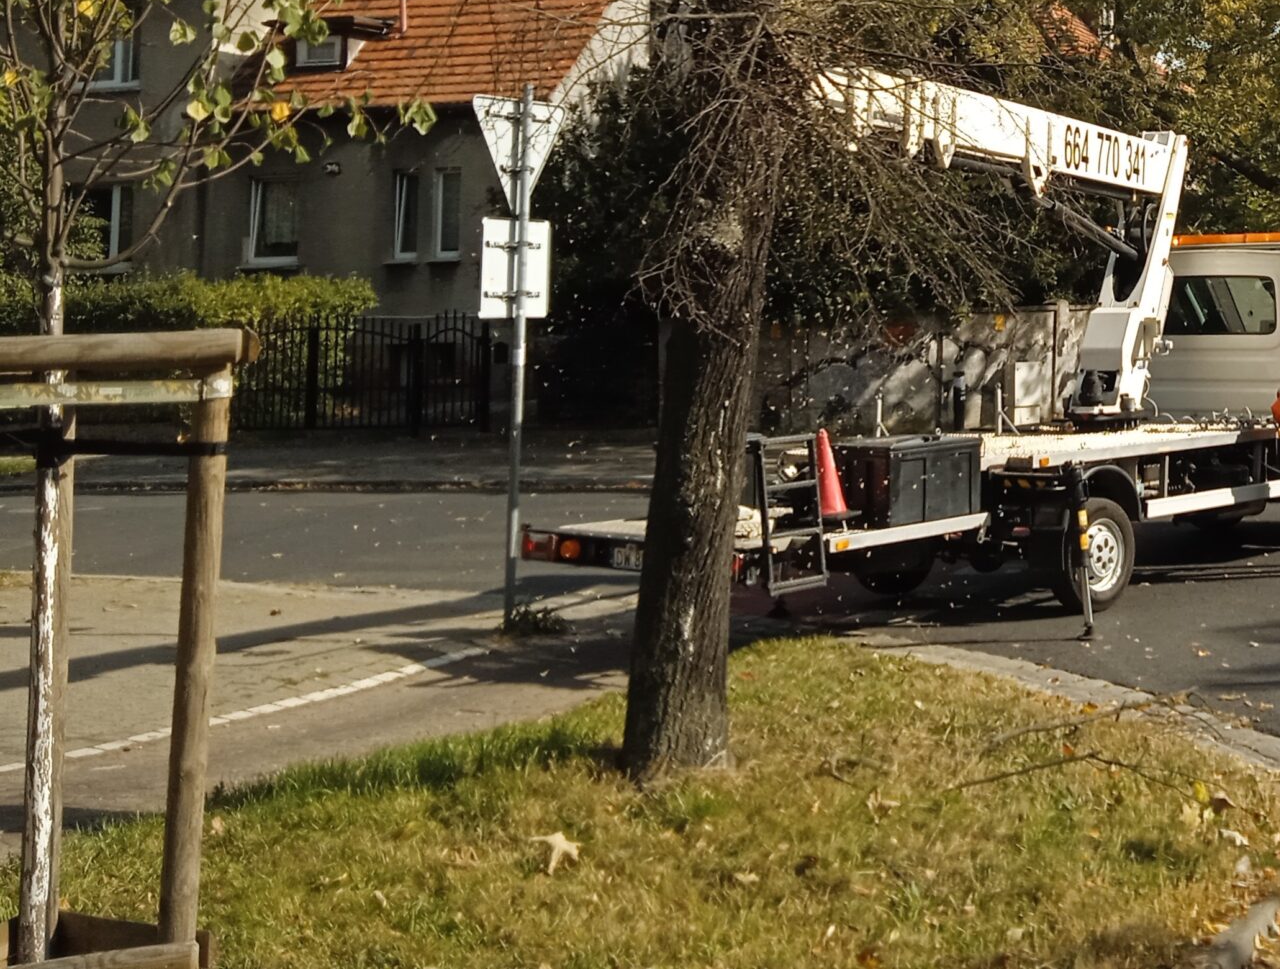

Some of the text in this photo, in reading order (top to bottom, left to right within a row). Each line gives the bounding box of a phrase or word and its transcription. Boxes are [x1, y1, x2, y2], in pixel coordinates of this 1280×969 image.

[1064, 124, 1146, 185] 664 770 341
